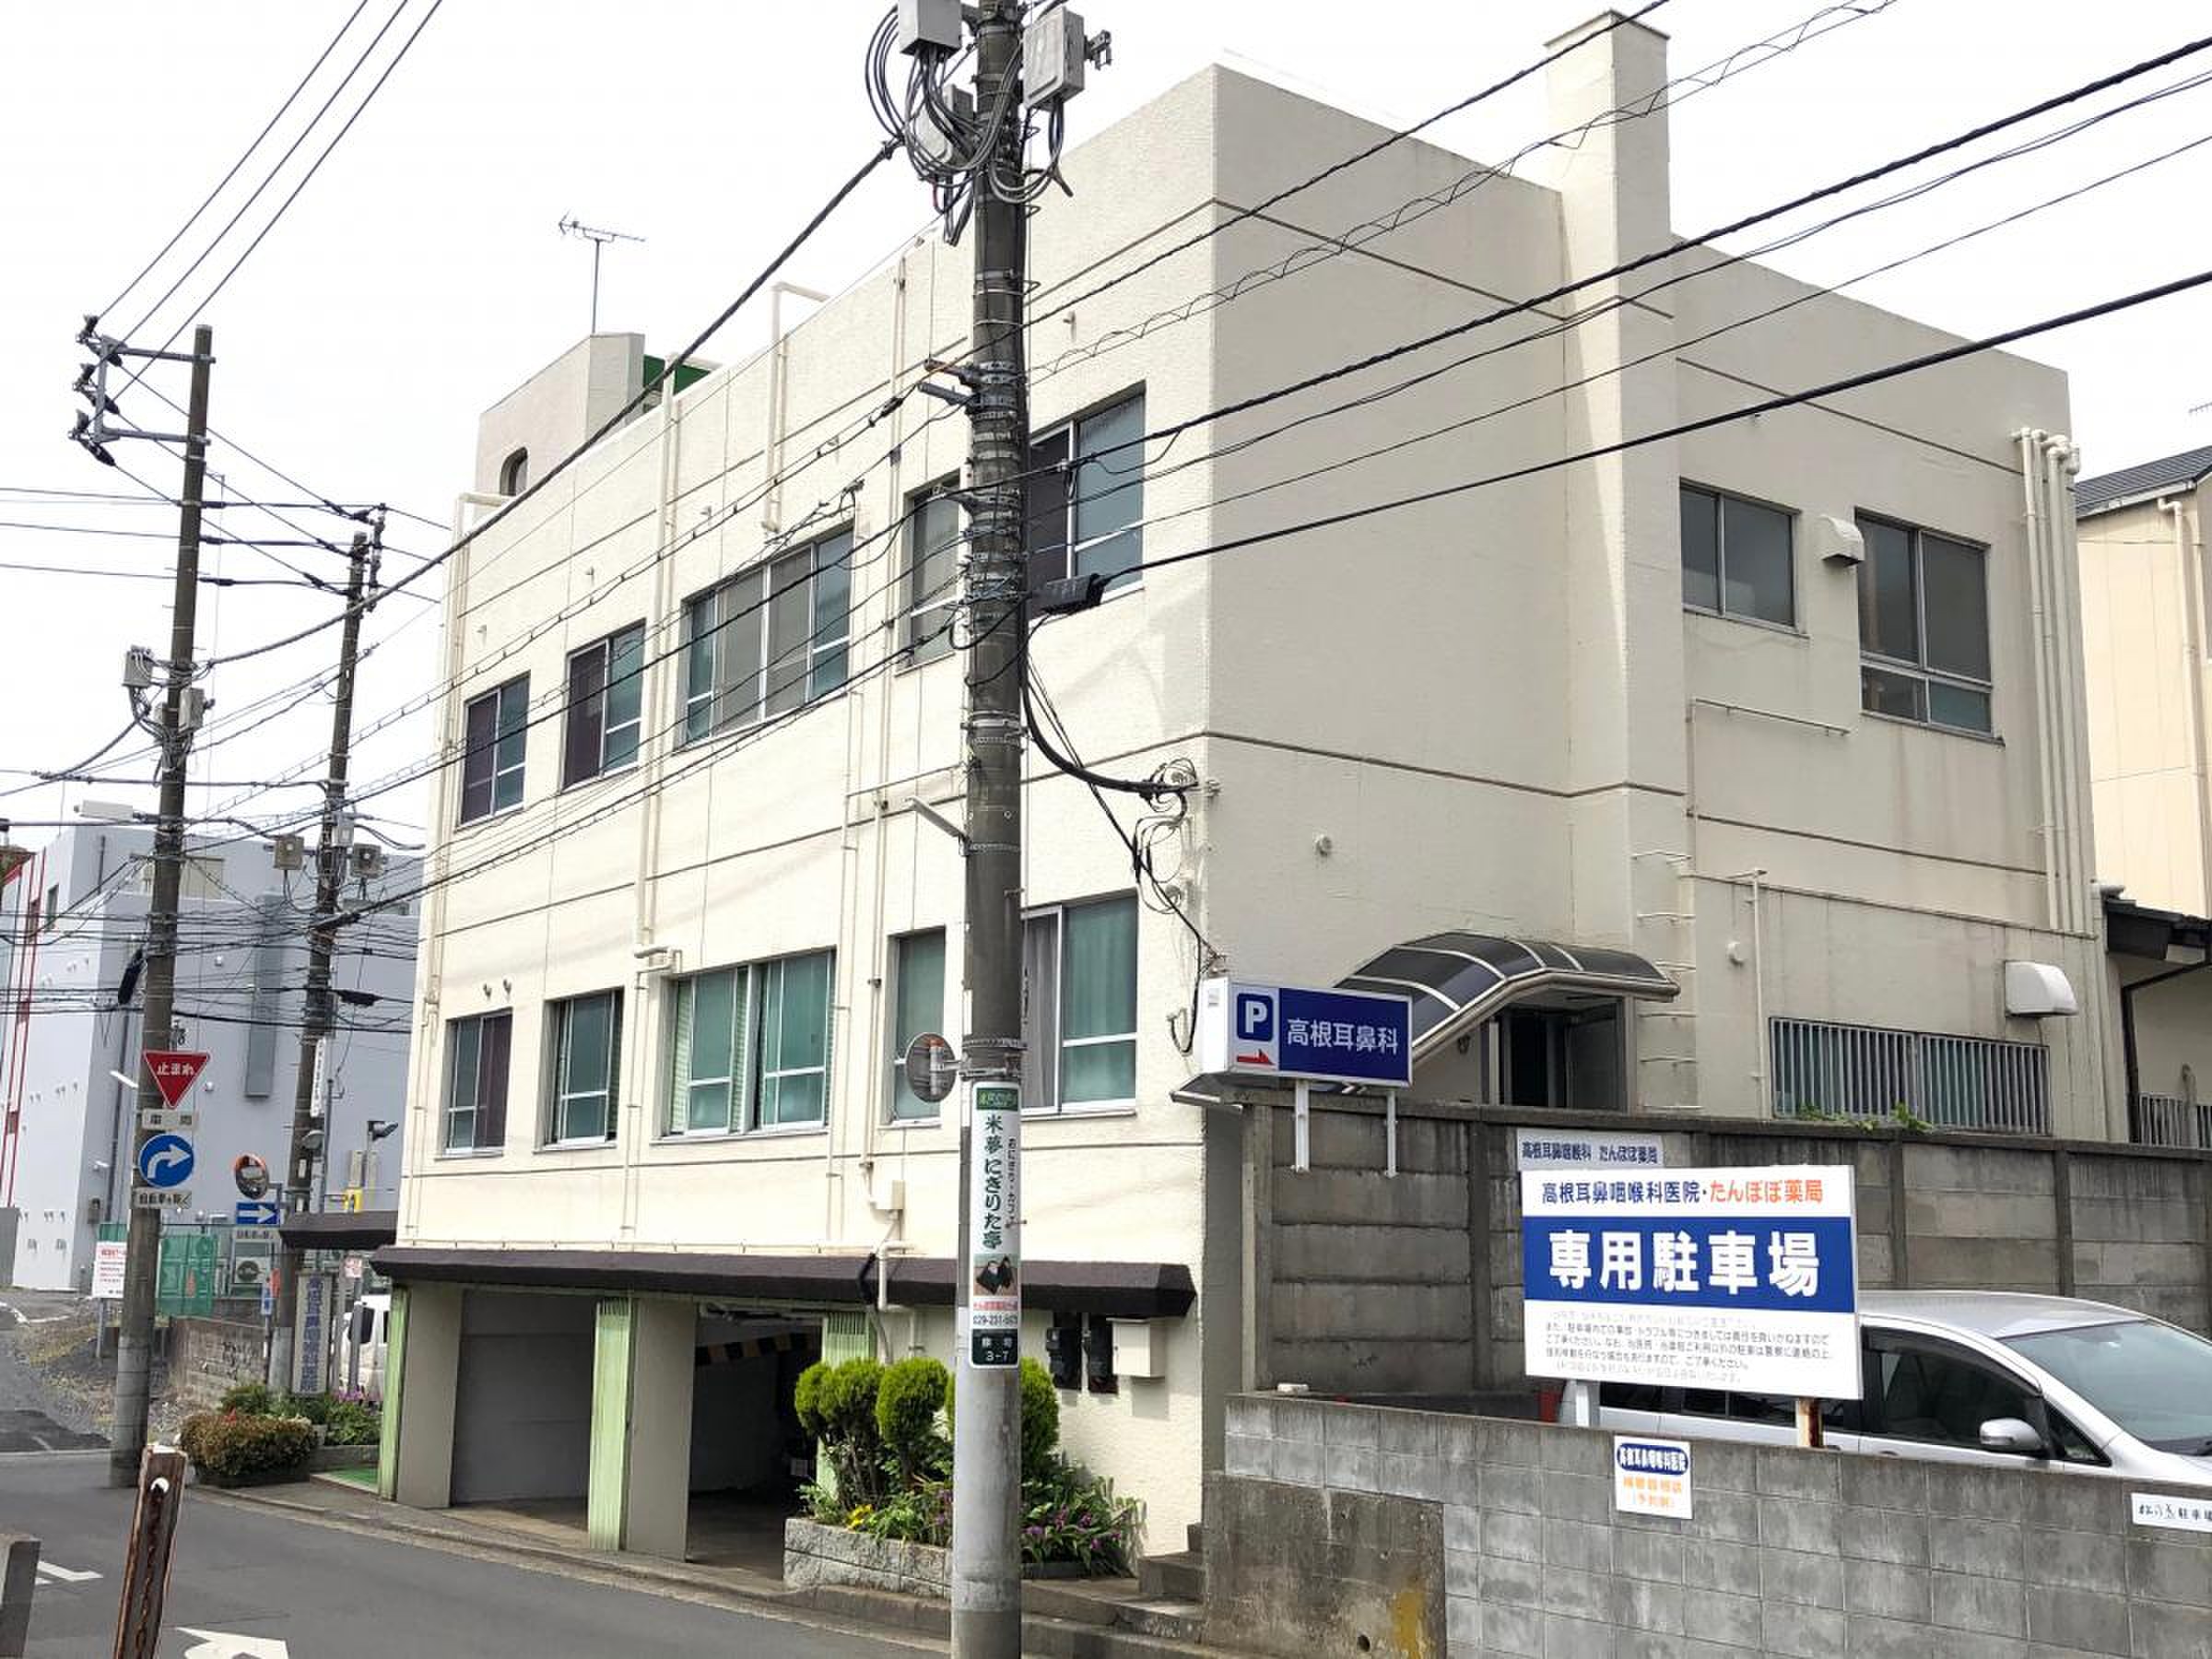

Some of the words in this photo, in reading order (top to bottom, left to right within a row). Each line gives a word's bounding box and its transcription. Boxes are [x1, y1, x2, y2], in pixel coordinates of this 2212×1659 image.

[1244, 1000, 1268, 1034] P
[1287, 1018, 1399, 1054] 高根耳鼻科
[157, 1062, 194, 1077] 止まれ
[1548, 1229, 1820, 1298] 専用駐車場
